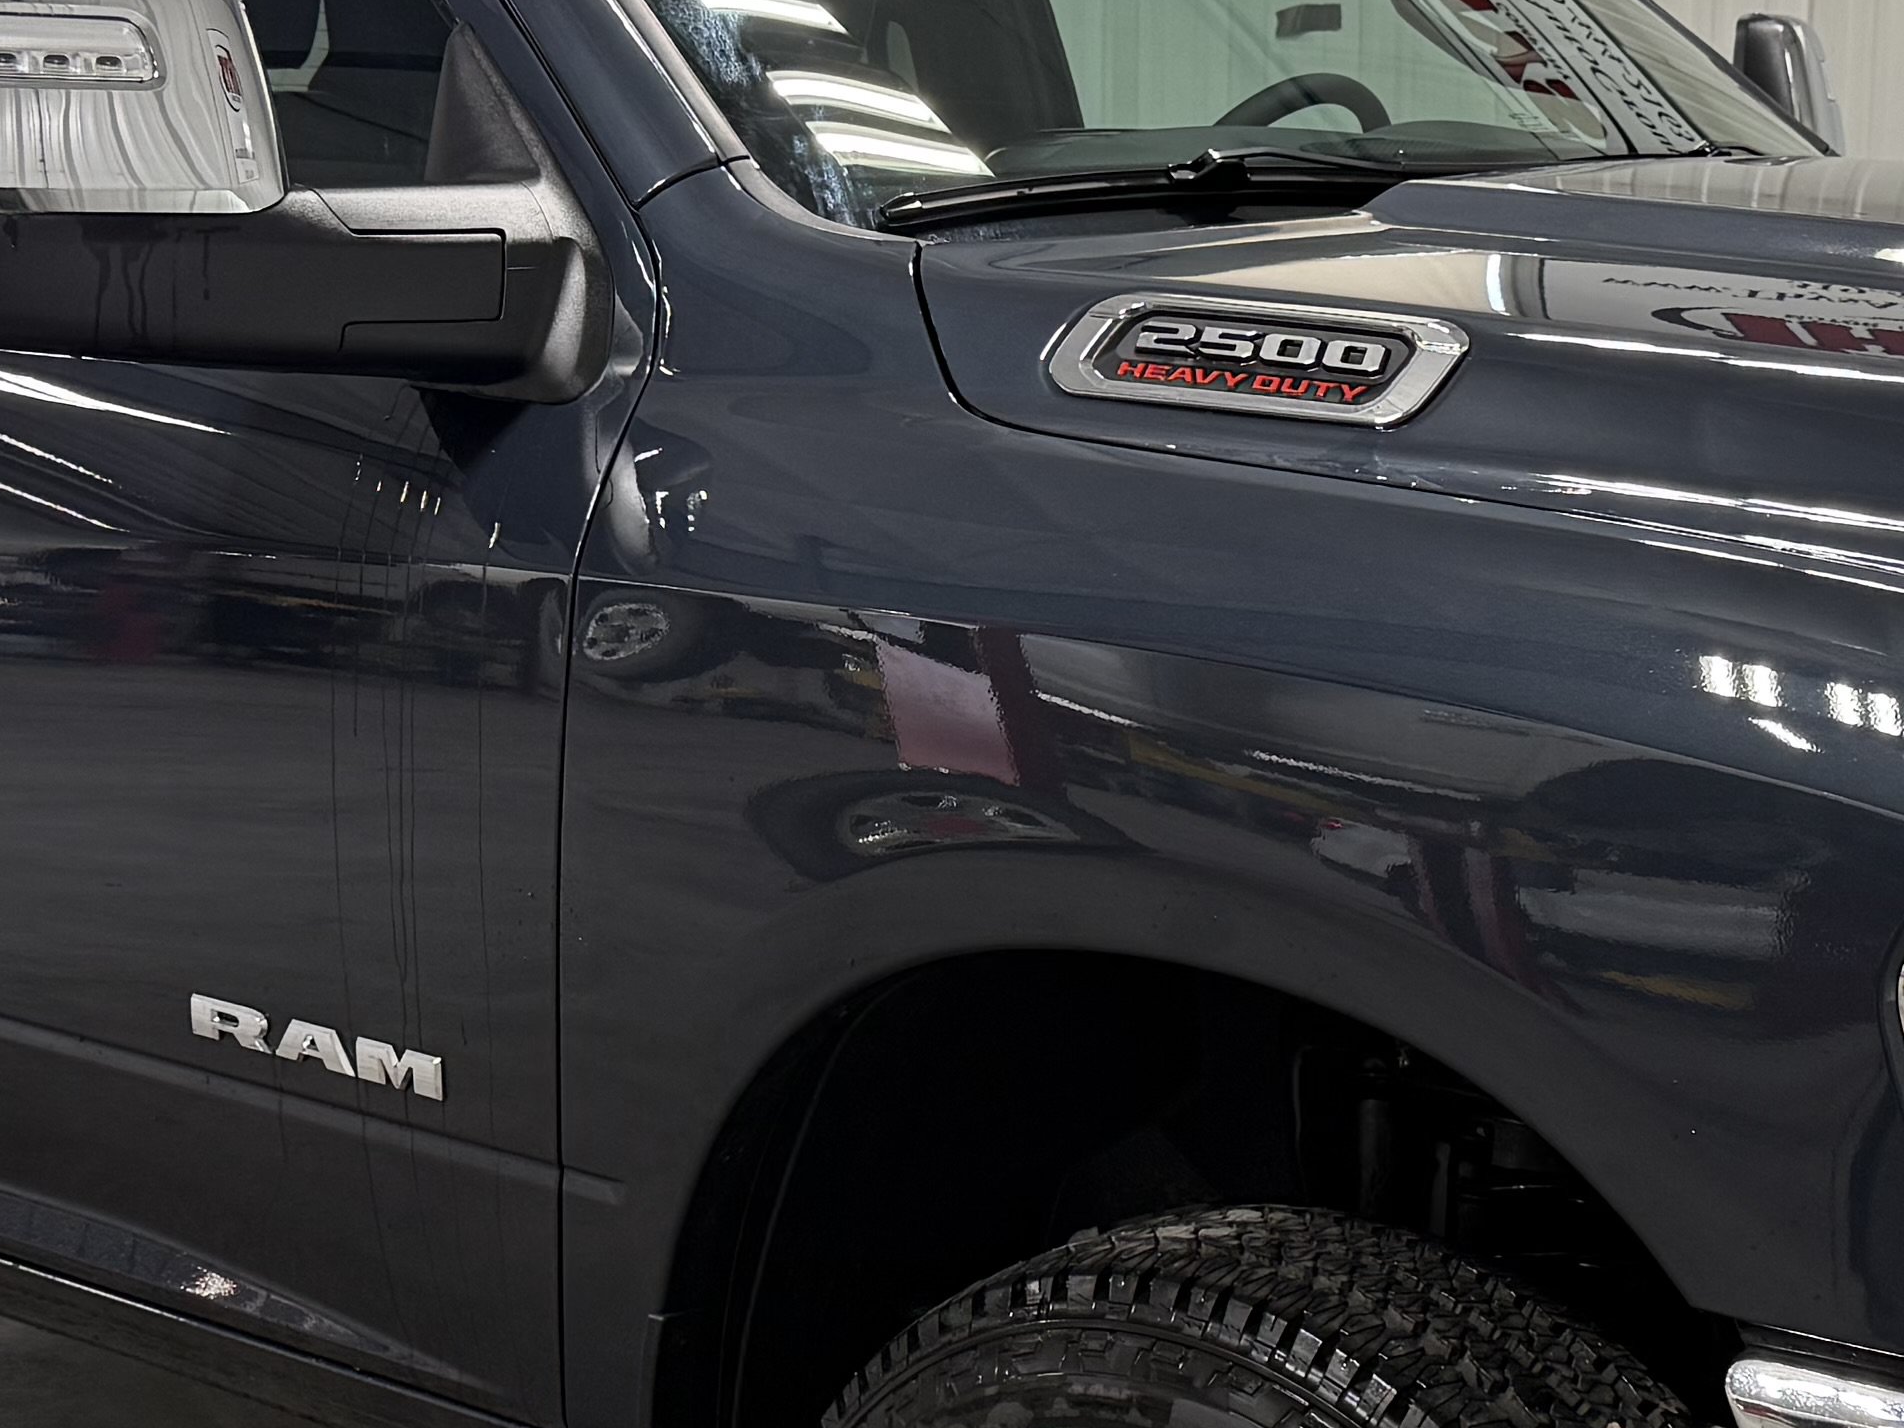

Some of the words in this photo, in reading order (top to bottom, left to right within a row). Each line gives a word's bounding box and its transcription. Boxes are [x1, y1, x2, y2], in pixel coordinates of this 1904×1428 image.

[1134, 320, 1389, 374] 2500
[1116, 360, 1250, 390] HEAVY
[1252, 377, 1369, 403] DUTY
[190, 992, 444, 1101] RAM
